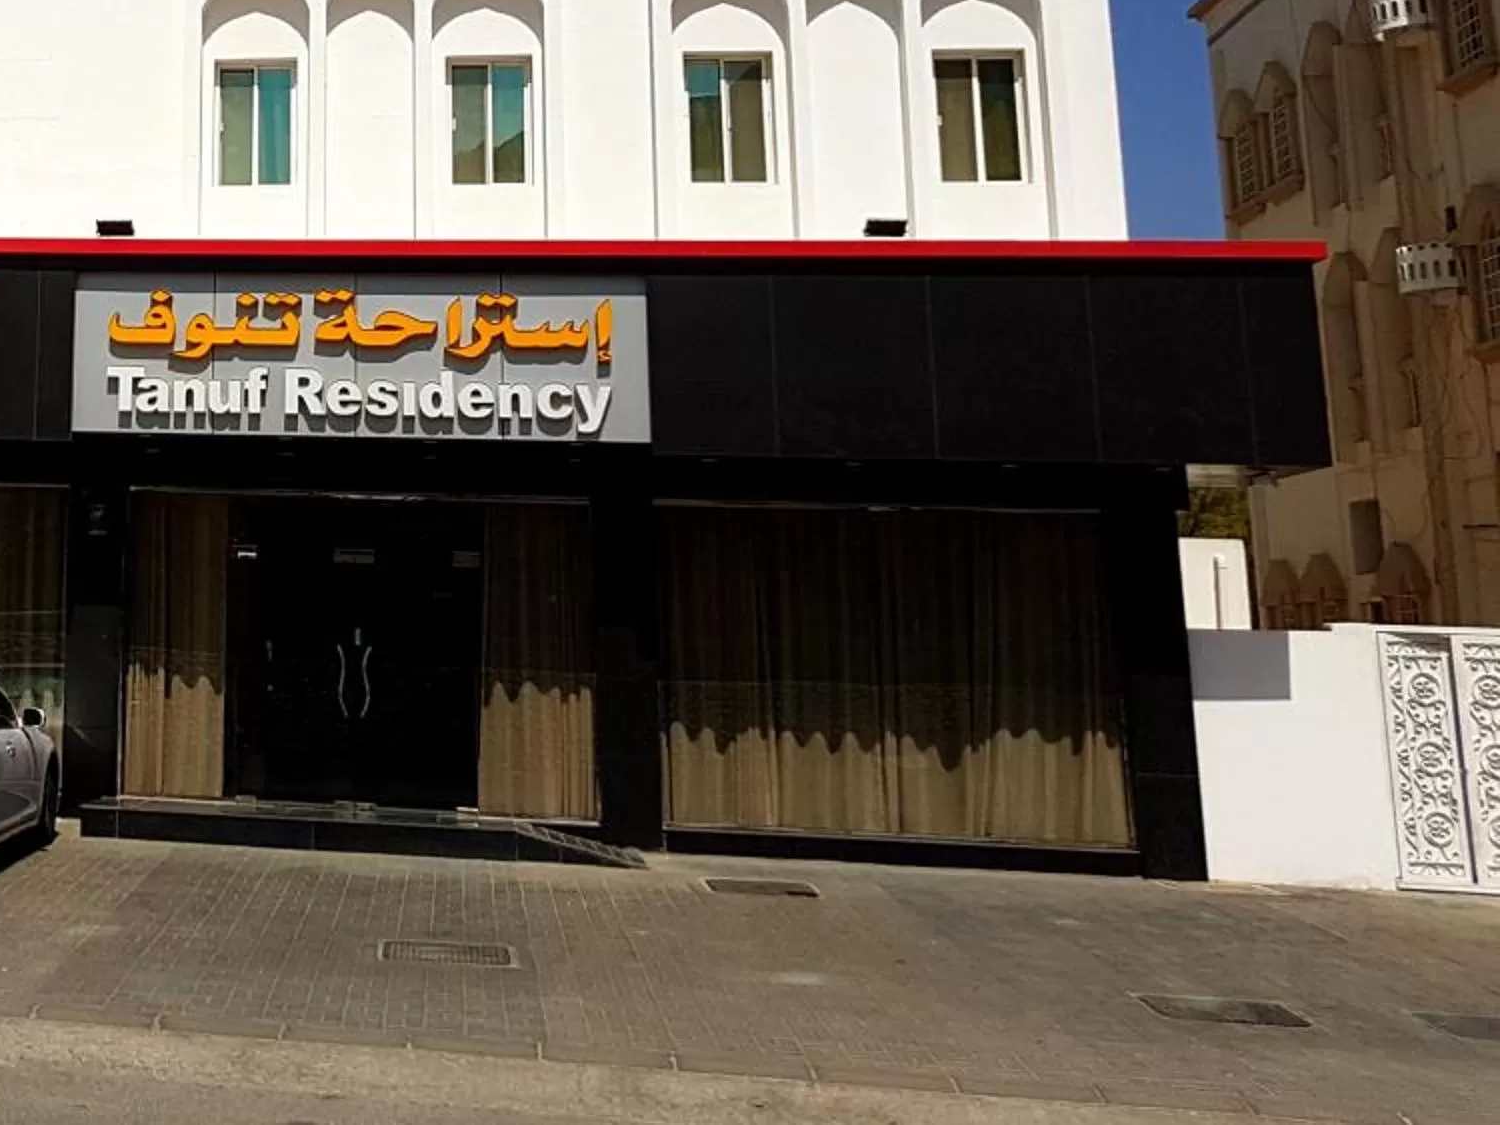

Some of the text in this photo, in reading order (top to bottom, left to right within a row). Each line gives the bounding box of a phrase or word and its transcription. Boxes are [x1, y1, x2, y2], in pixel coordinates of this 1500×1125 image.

[107, 288, 615, 361] إستراحة تنوف
[105, 365, 612, 434] Tanuf Residency
